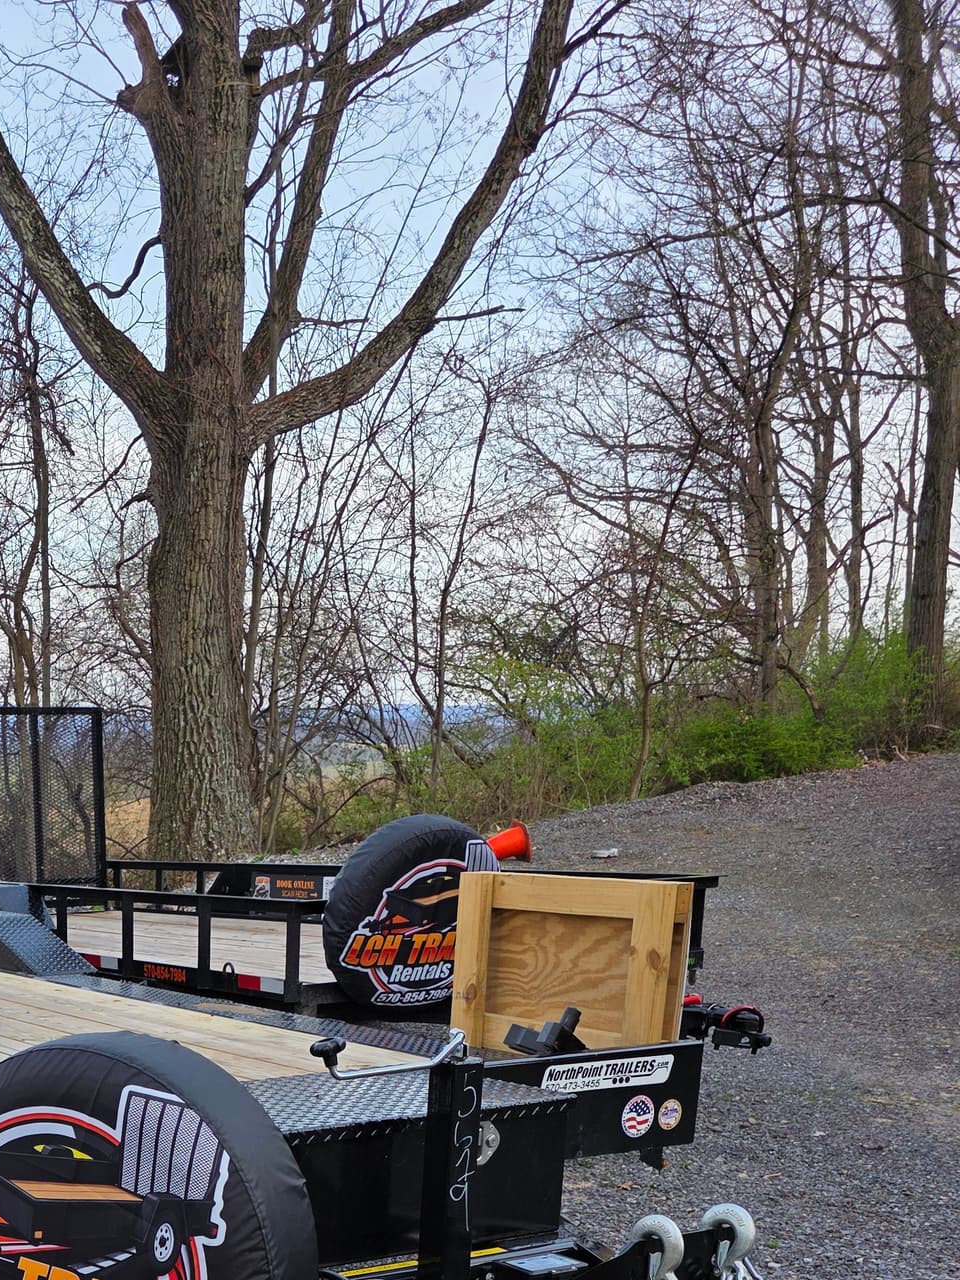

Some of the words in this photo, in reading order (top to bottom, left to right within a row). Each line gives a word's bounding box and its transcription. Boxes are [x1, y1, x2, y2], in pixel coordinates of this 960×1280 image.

[344, 935, 403, 967] LCH
[389, 961, 453, 983] Rentals
[546, 1064, 603, 1082] NorthPoint
[604, 1059, 657, 1077] TRAILERS
[544, 1079, 601, 1092] 570-473-3455
